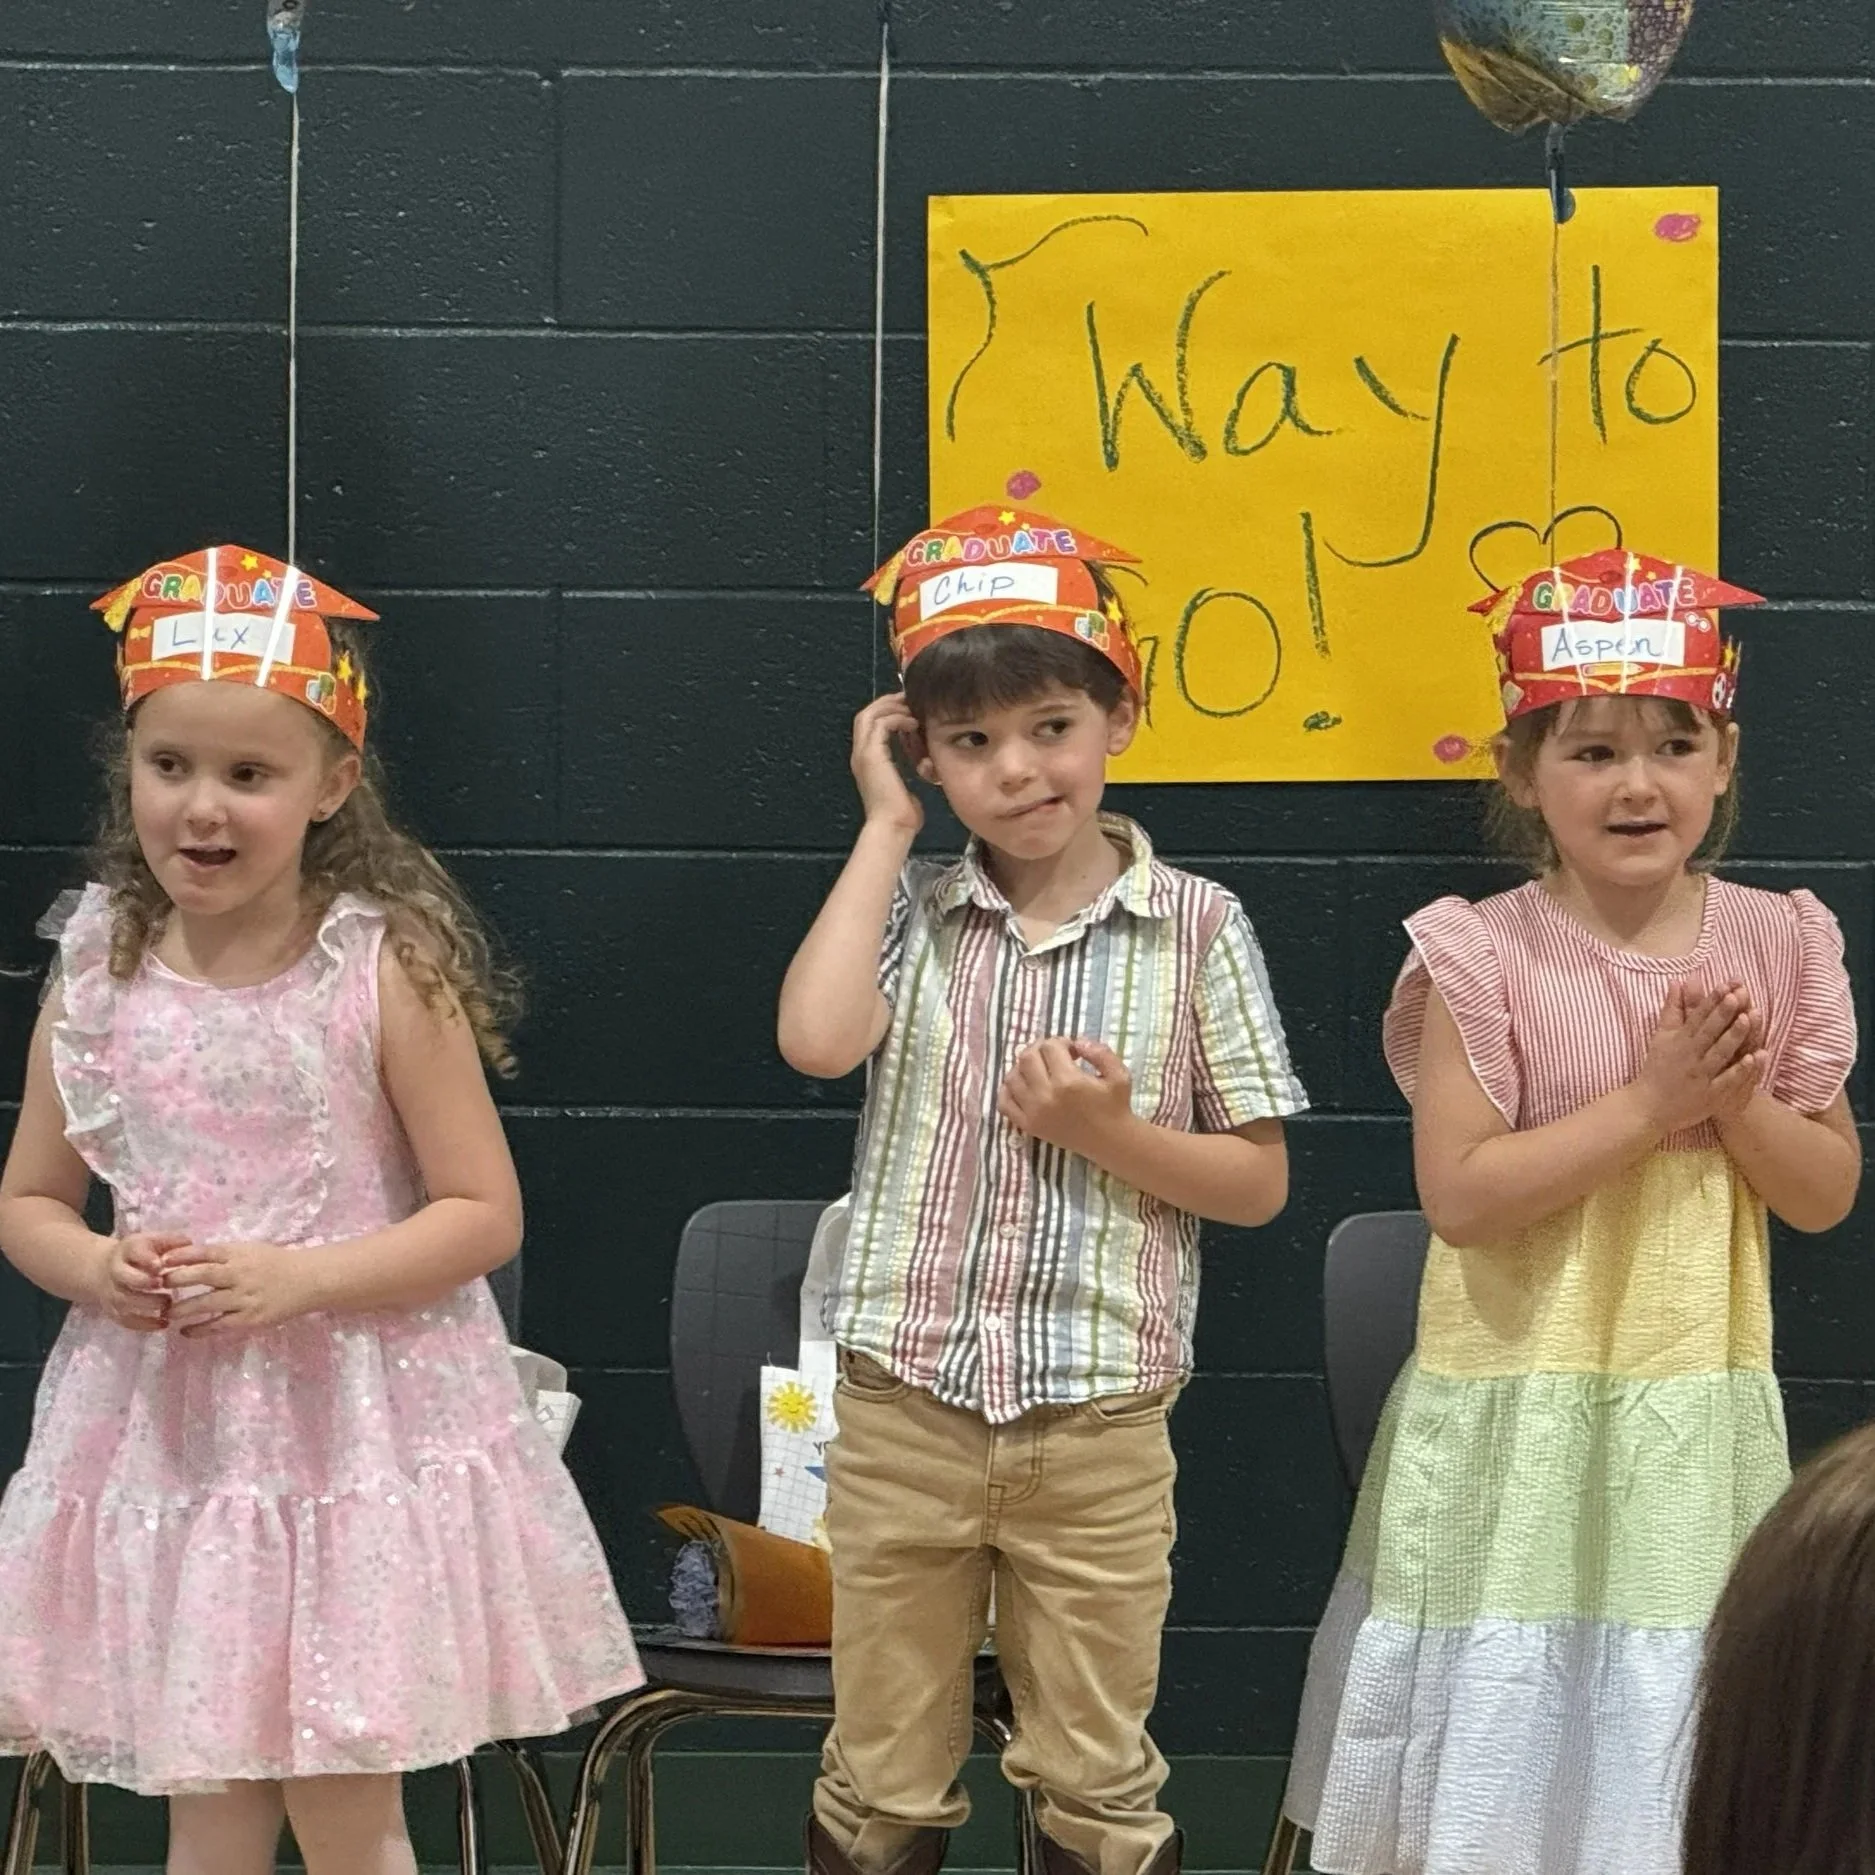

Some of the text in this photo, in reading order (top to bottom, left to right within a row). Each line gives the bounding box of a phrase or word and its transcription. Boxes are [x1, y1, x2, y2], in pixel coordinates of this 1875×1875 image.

[1086, 264, 1697, 568] Way to
[906, 529, 1077, 567] GRADUATE
[142, 570, 318, 610] GRADUATE
[934, 571, 1015, 606] Chip
[1532, 577, 1698, 617] GRADUATE
[1551, 627, 1663, 662] Aspen
